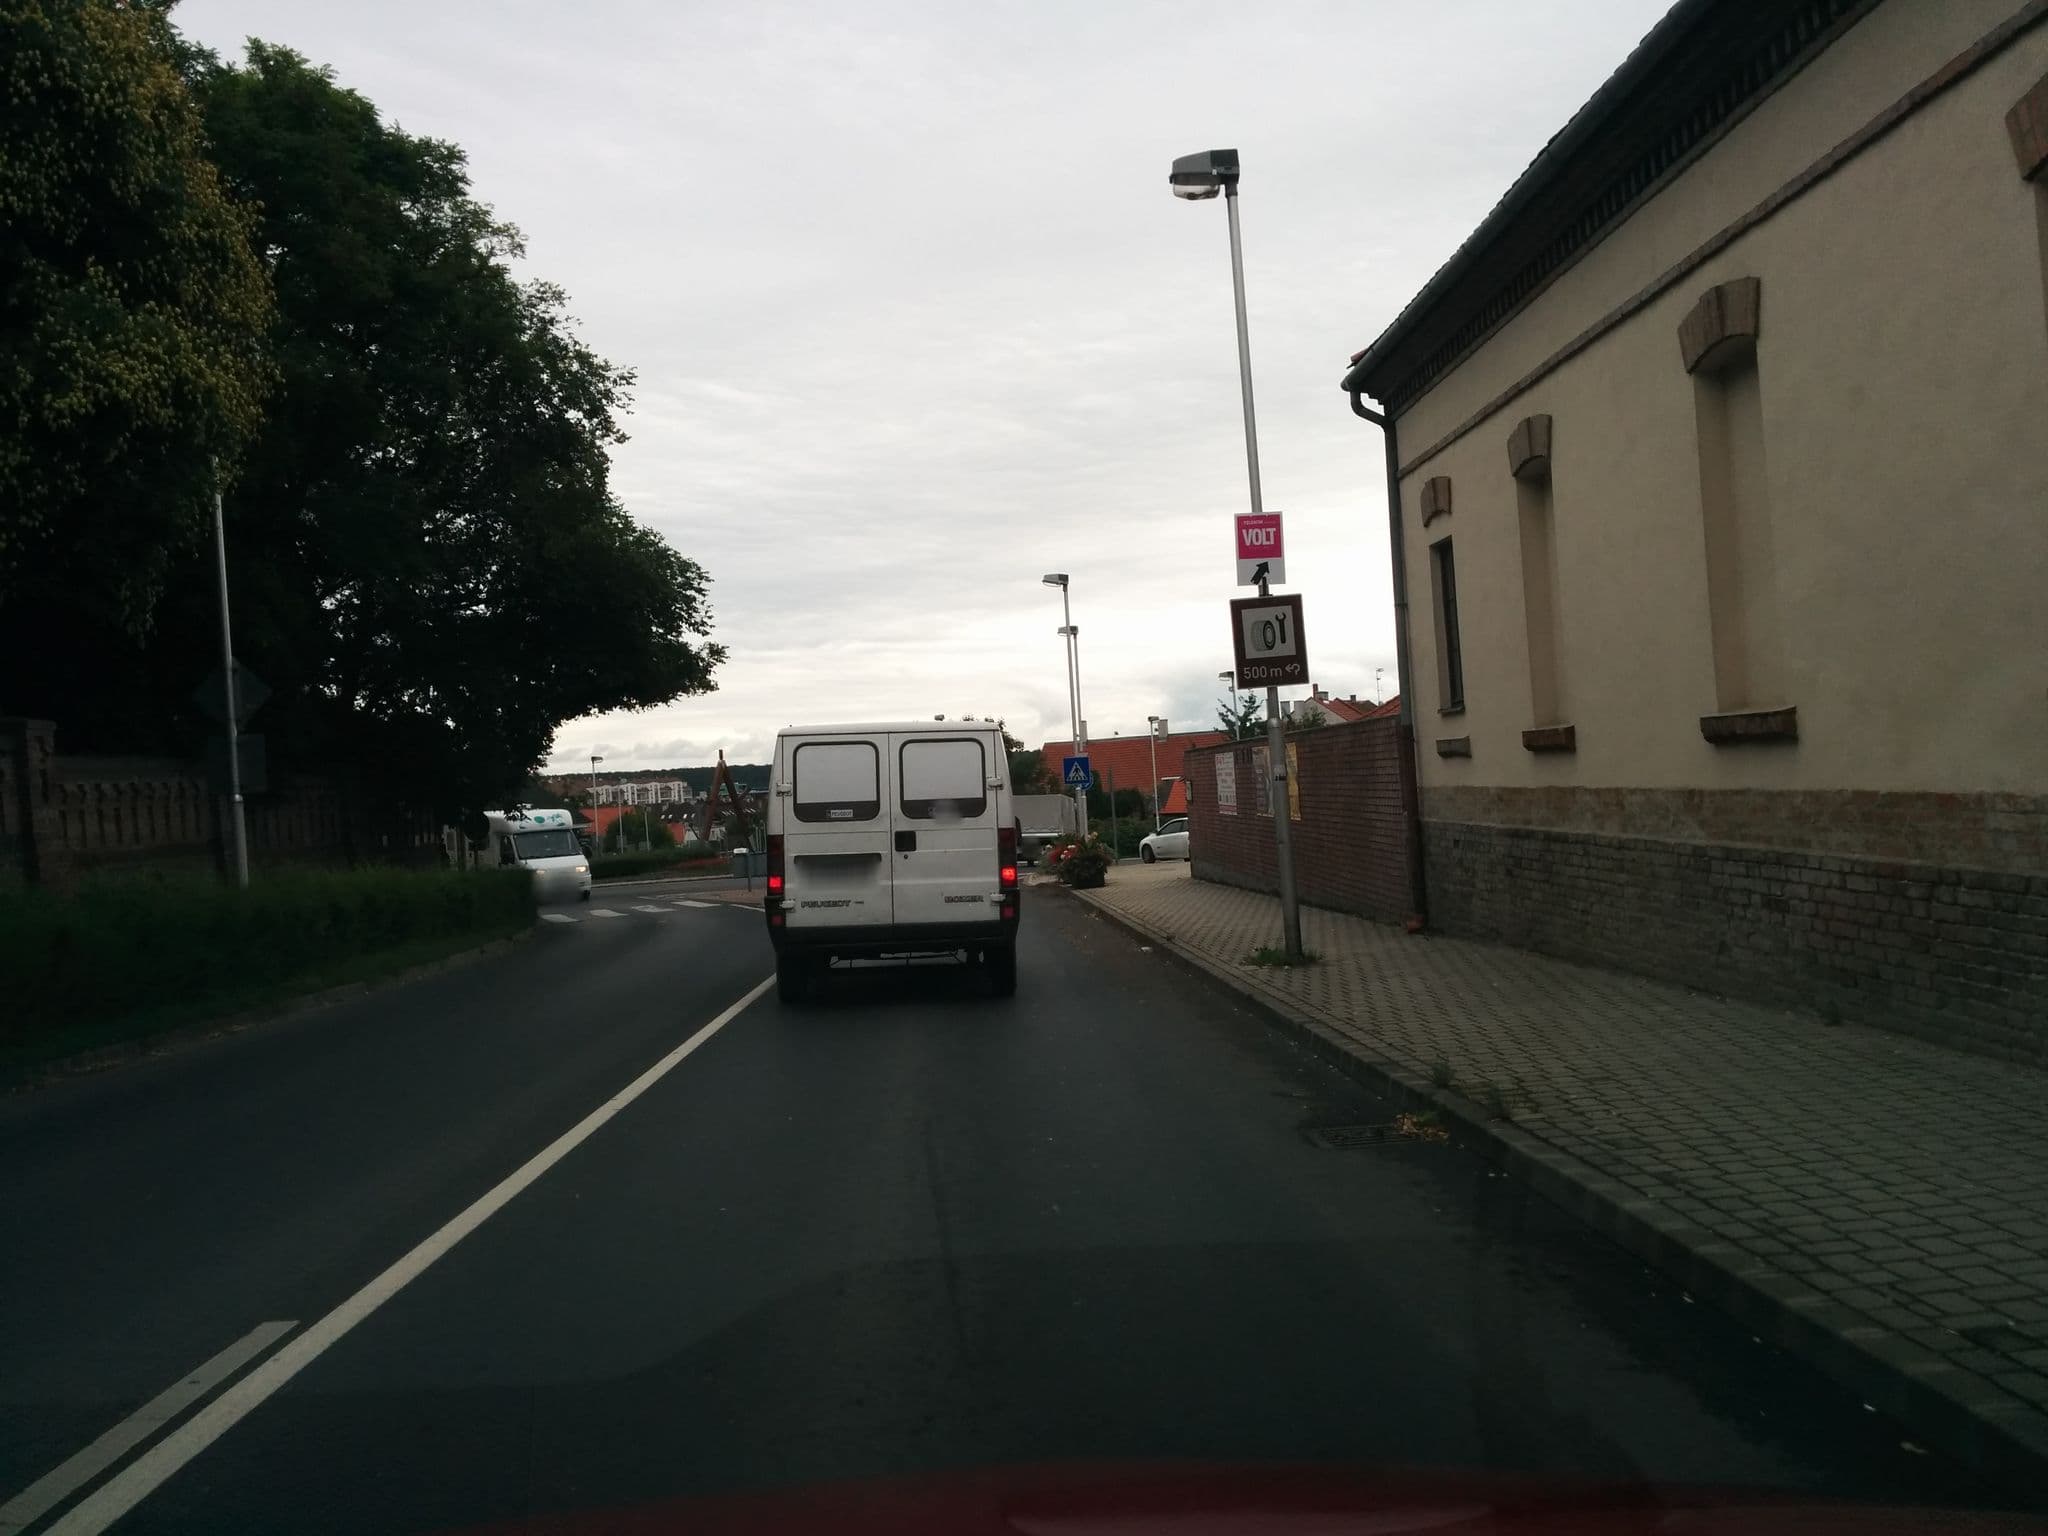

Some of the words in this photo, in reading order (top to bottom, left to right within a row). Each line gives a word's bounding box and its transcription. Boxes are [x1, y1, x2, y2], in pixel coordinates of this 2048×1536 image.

[1242, 527, 1276, 546] VOLT
[1243, 666, 1268, 680] 500
[1269, 667, 1282, 677] m
